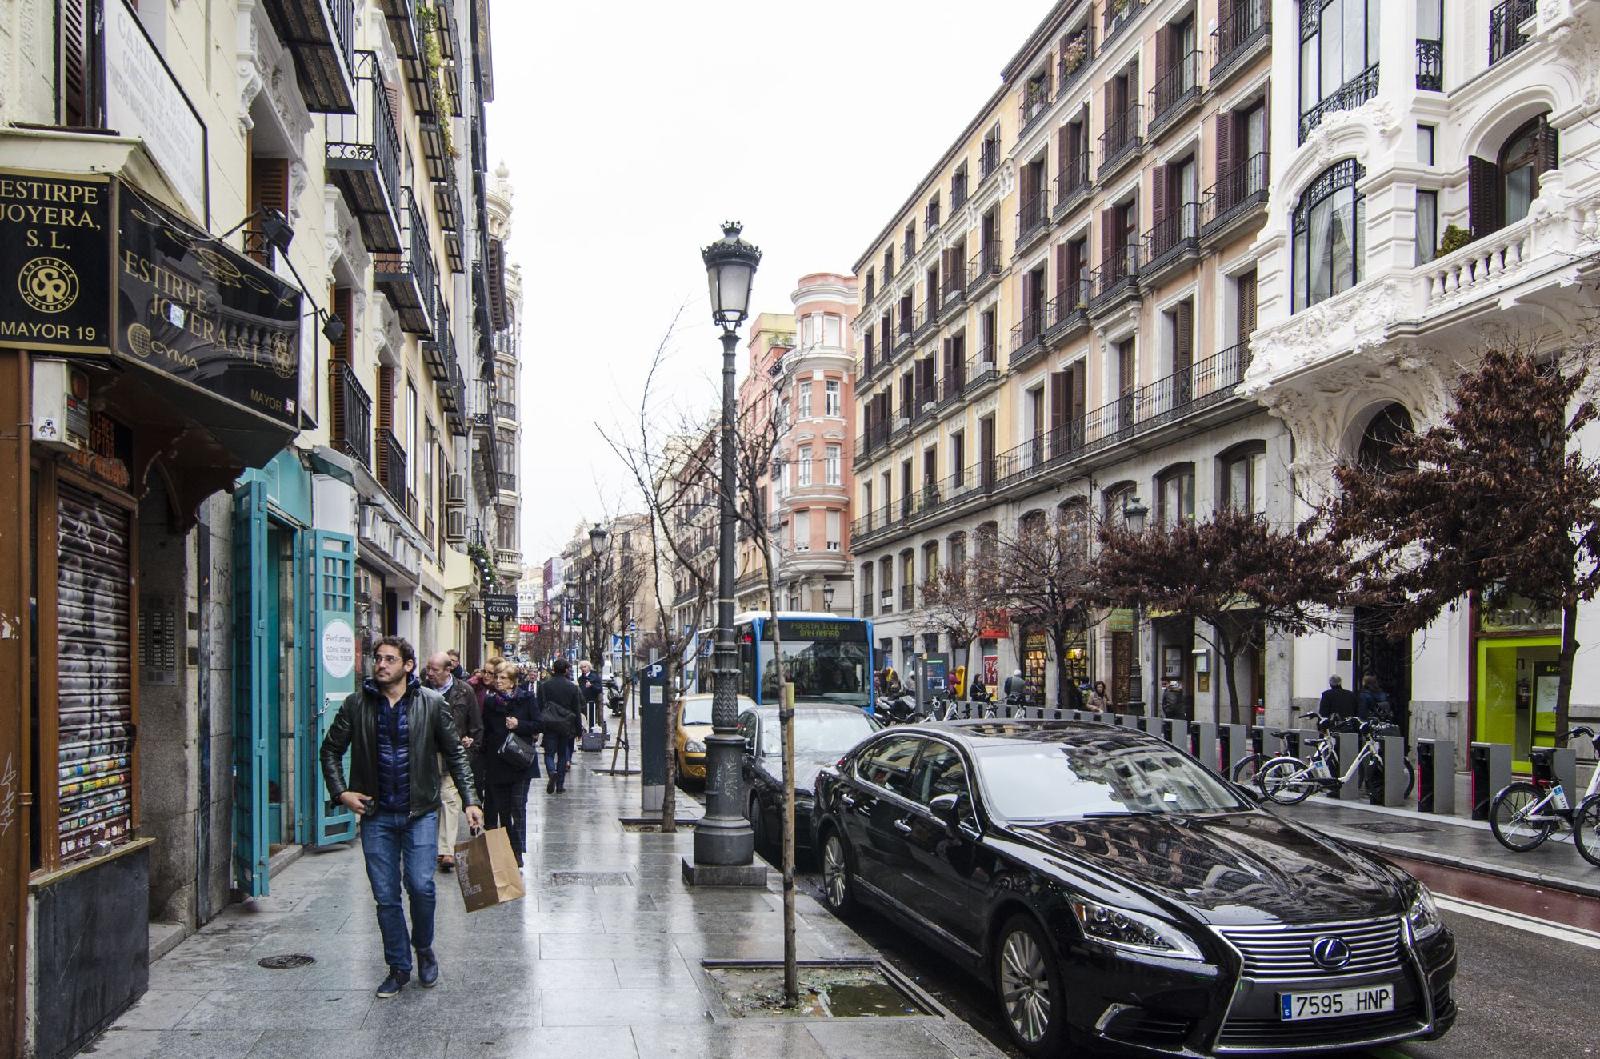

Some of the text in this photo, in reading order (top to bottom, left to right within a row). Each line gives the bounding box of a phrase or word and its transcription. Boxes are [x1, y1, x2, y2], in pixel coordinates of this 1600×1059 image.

[0, 180, 99, 205] ESTIRPE
[0, 203, 101, 231] JOYERA,
[26, 229, 71, 249] S. L.
[125, 250, 208, 313] ESTIRPE
[1, 320, 96, 341] MAYOR 19
[151, 341, 200, 371] CYMA
[1297, 994, 1343, 1016] 7595
[1357, 989, 1389, 1011] HNP
